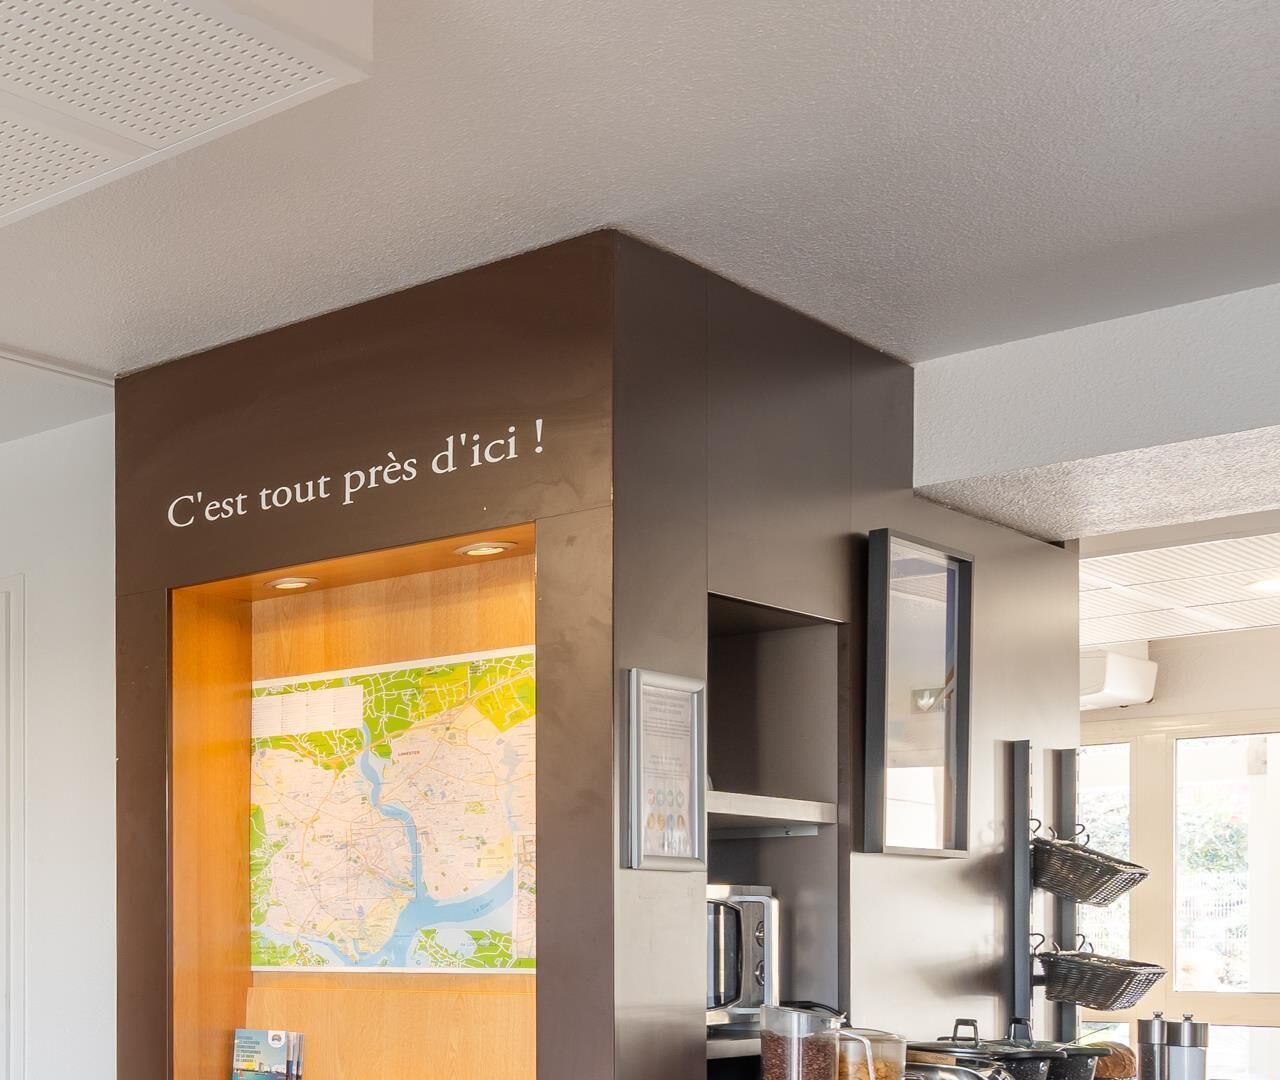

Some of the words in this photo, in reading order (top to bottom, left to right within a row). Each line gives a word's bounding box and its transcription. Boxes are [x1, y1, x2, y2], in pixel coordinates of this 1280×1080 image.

[166, 491, 248, 528] C'est
[259, 474, 331, 512] tout
[341, 451, 418, 505] près
[431, 425, 519, 475] d'ici
[533, 418, 544, 454] !
